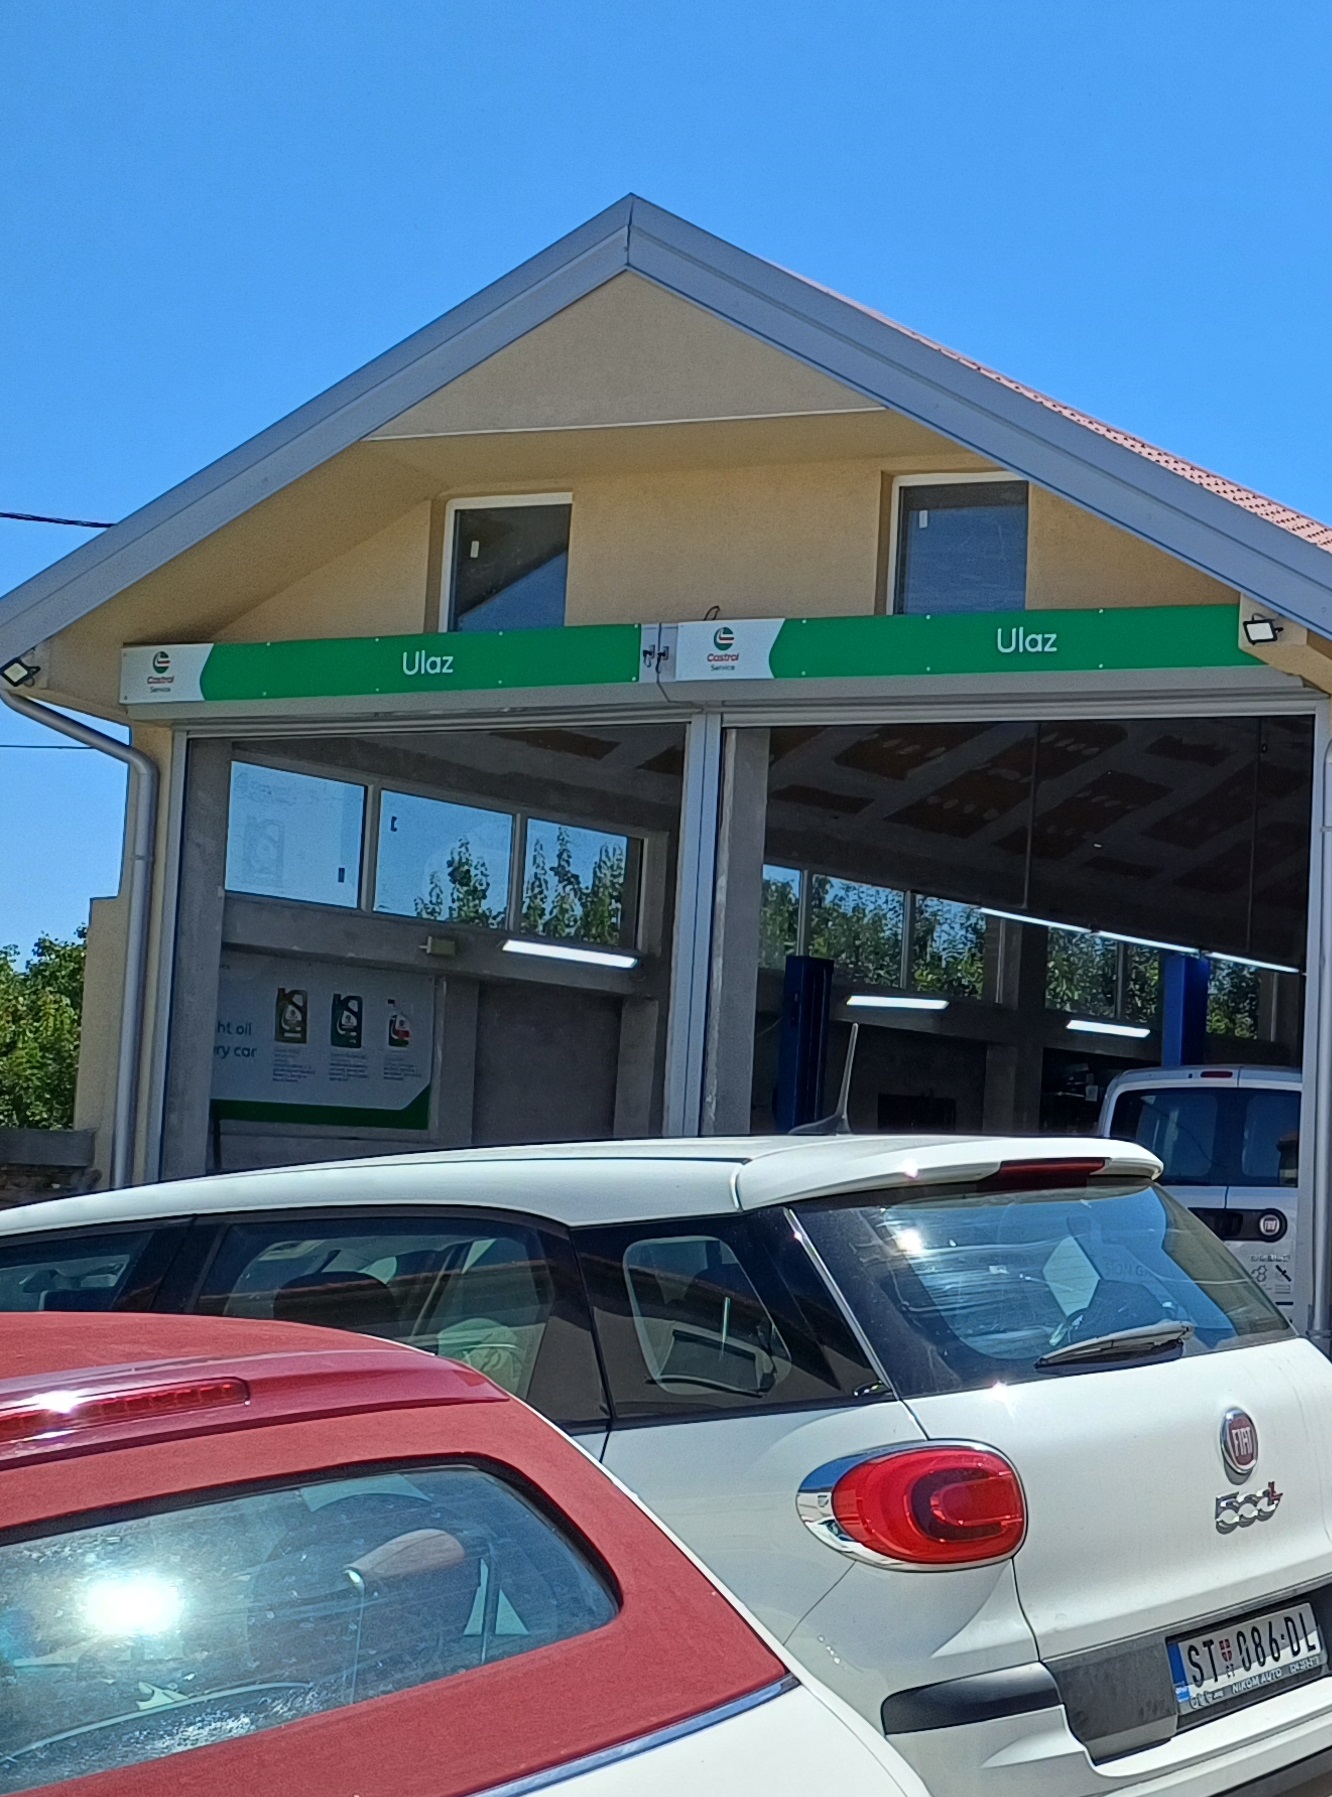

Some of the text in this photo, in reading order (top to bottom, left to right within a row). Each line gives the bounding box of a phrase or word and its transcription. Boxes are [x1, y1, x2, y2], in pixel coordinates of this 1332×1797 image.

[996, 627, 1058, 654] Ulaz
[402, 650, 455, 676] Ulaz
[707, 652, 740, 663] Castrol
[236, 1022, 254, 1037] oil
[233, 1047, 258, 1059] car
[1231, 1426, 1253, 1458] FIAT
[1187, 1639, 1219, 1689] ST
[1231, 1667, 1283, 1695] NIKOM AUTO
